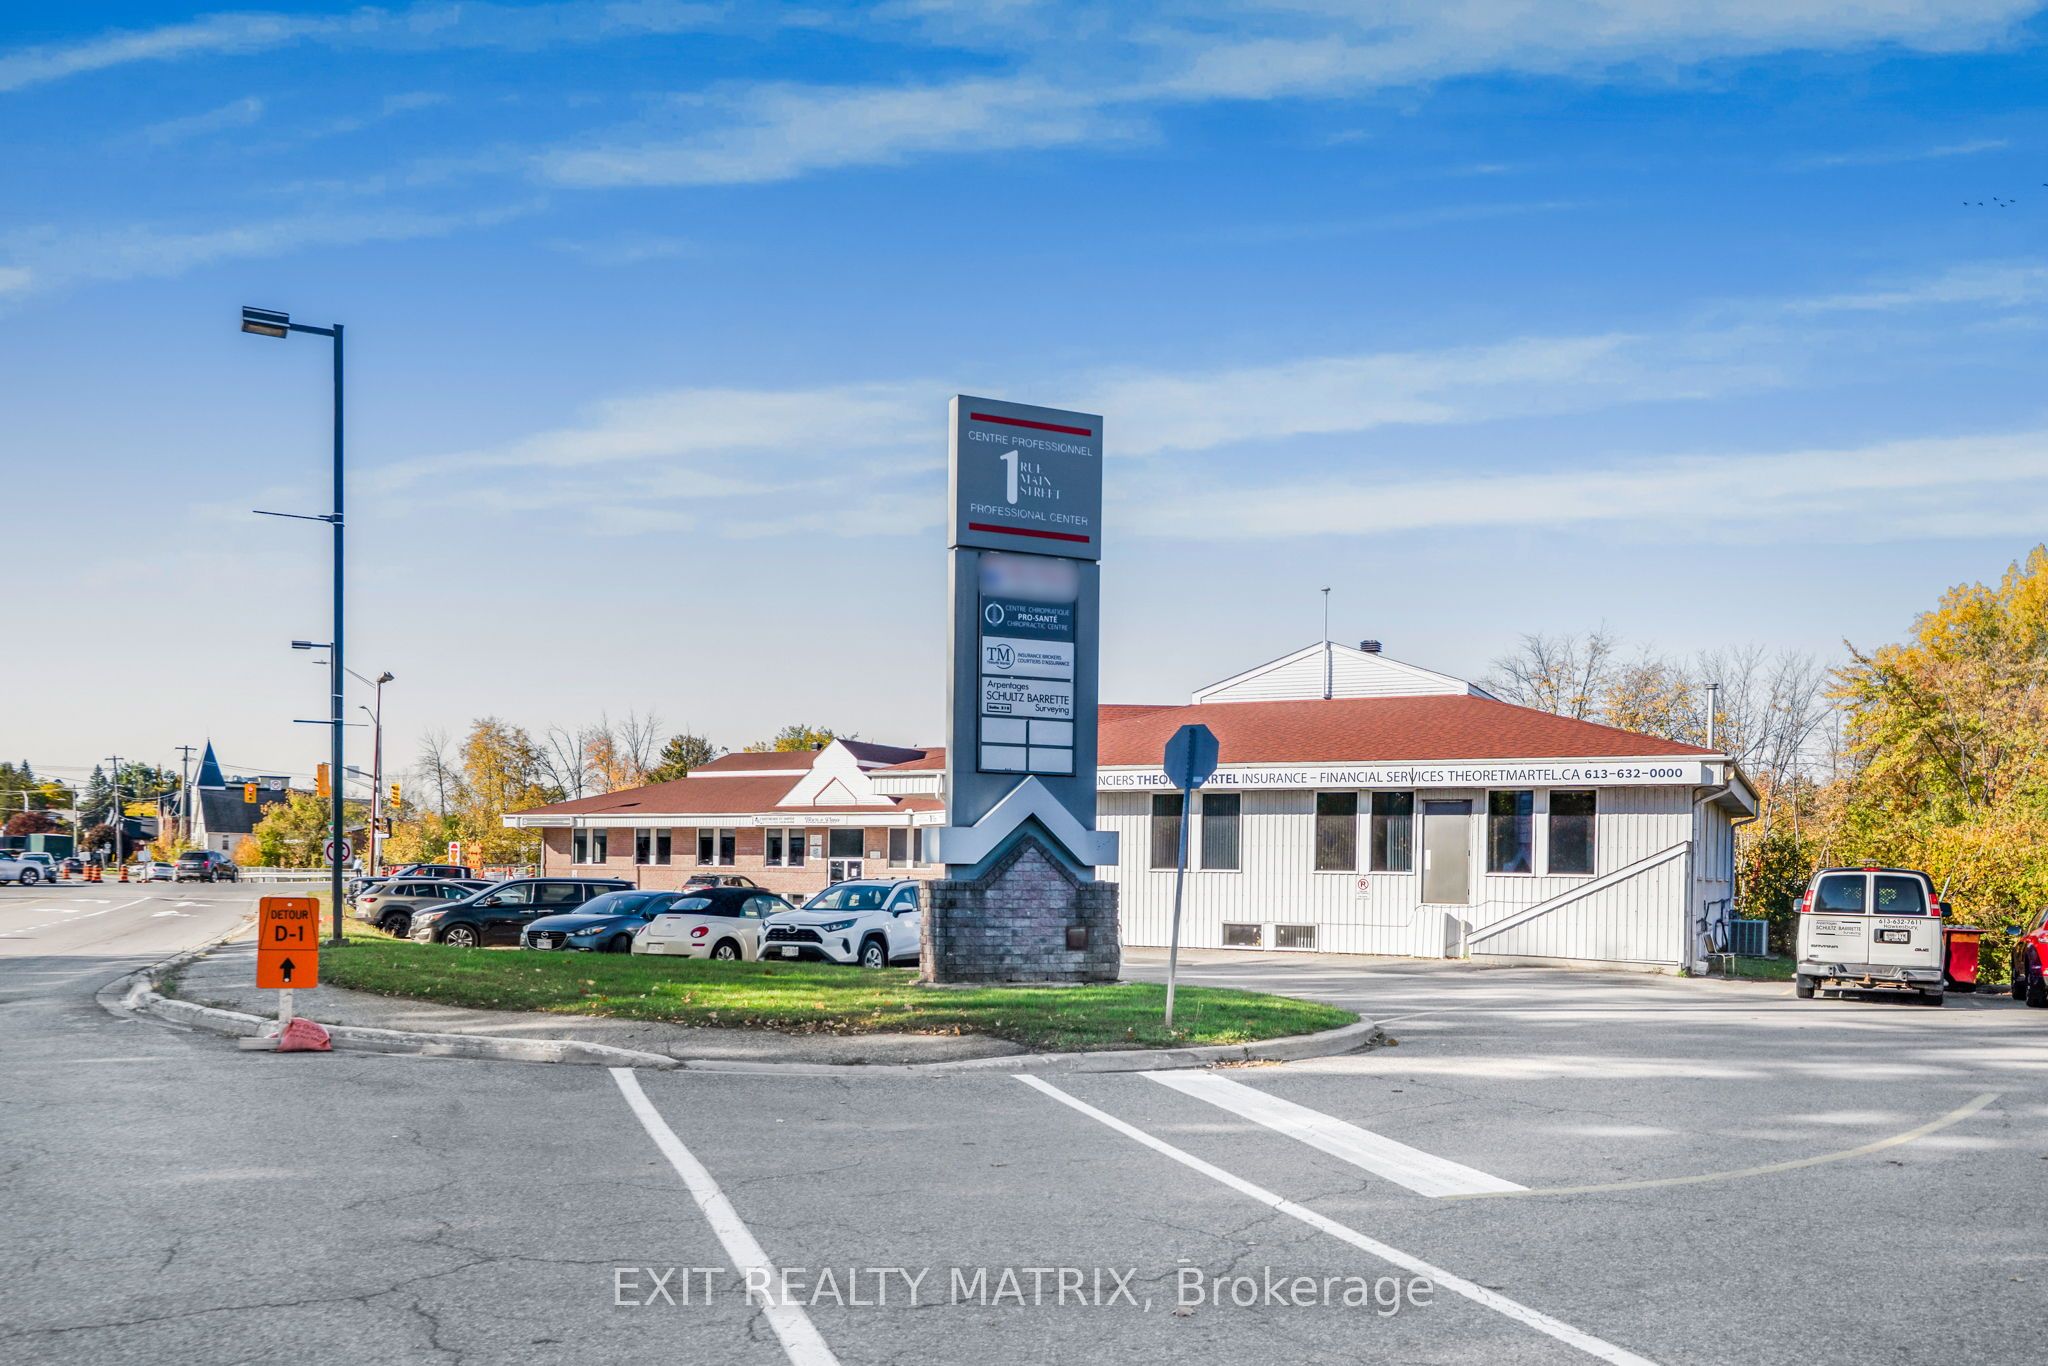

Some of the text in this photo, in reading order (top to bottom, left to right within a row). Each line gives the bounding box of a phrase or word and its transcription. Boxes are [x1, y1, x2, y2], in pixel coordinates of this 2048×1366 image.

[968, 431, 1093, 456] CENTRE PROFESSIONNEL
[1020, 462, 1042, 474] RUE
[1000, 449, 1018, 505] 1
[1020, 474, 1051, 486] MAIN
[1020, 486, 1060, 500] STREET
[970, 503, 1088, 526] PROFESSIONAL CENTER
[1006, 604, 1026, 613] CENTRE
[1018, 613, 1058, 623] PRO-SANTÉ
[1007, 620, 1068, 631] CHIROPRACTIC CENTRE
[986, 647, 1010, 662] TM
[987, 679, 1029, 691] Arpentages
[986, 690, 1069, 705] SCHULTZ BARRETTE
[1035, 703, 1069, 715] Surveying
[1136, 774, 1172, 785] THEO
[1242, 772, 1307, 785] INSURANCE
[1320, 771, 1383, 783] FINANCIAL
[1387, 770, 1444, 783] SERVICES
[1448, 768, 1581, 782] THEORETMARTEL.CA
[1584, 767, 1683, 780] 613-632-0000
[271, 909, 309, 920] DETOUR
[275, 925, 304, 942] D-1
